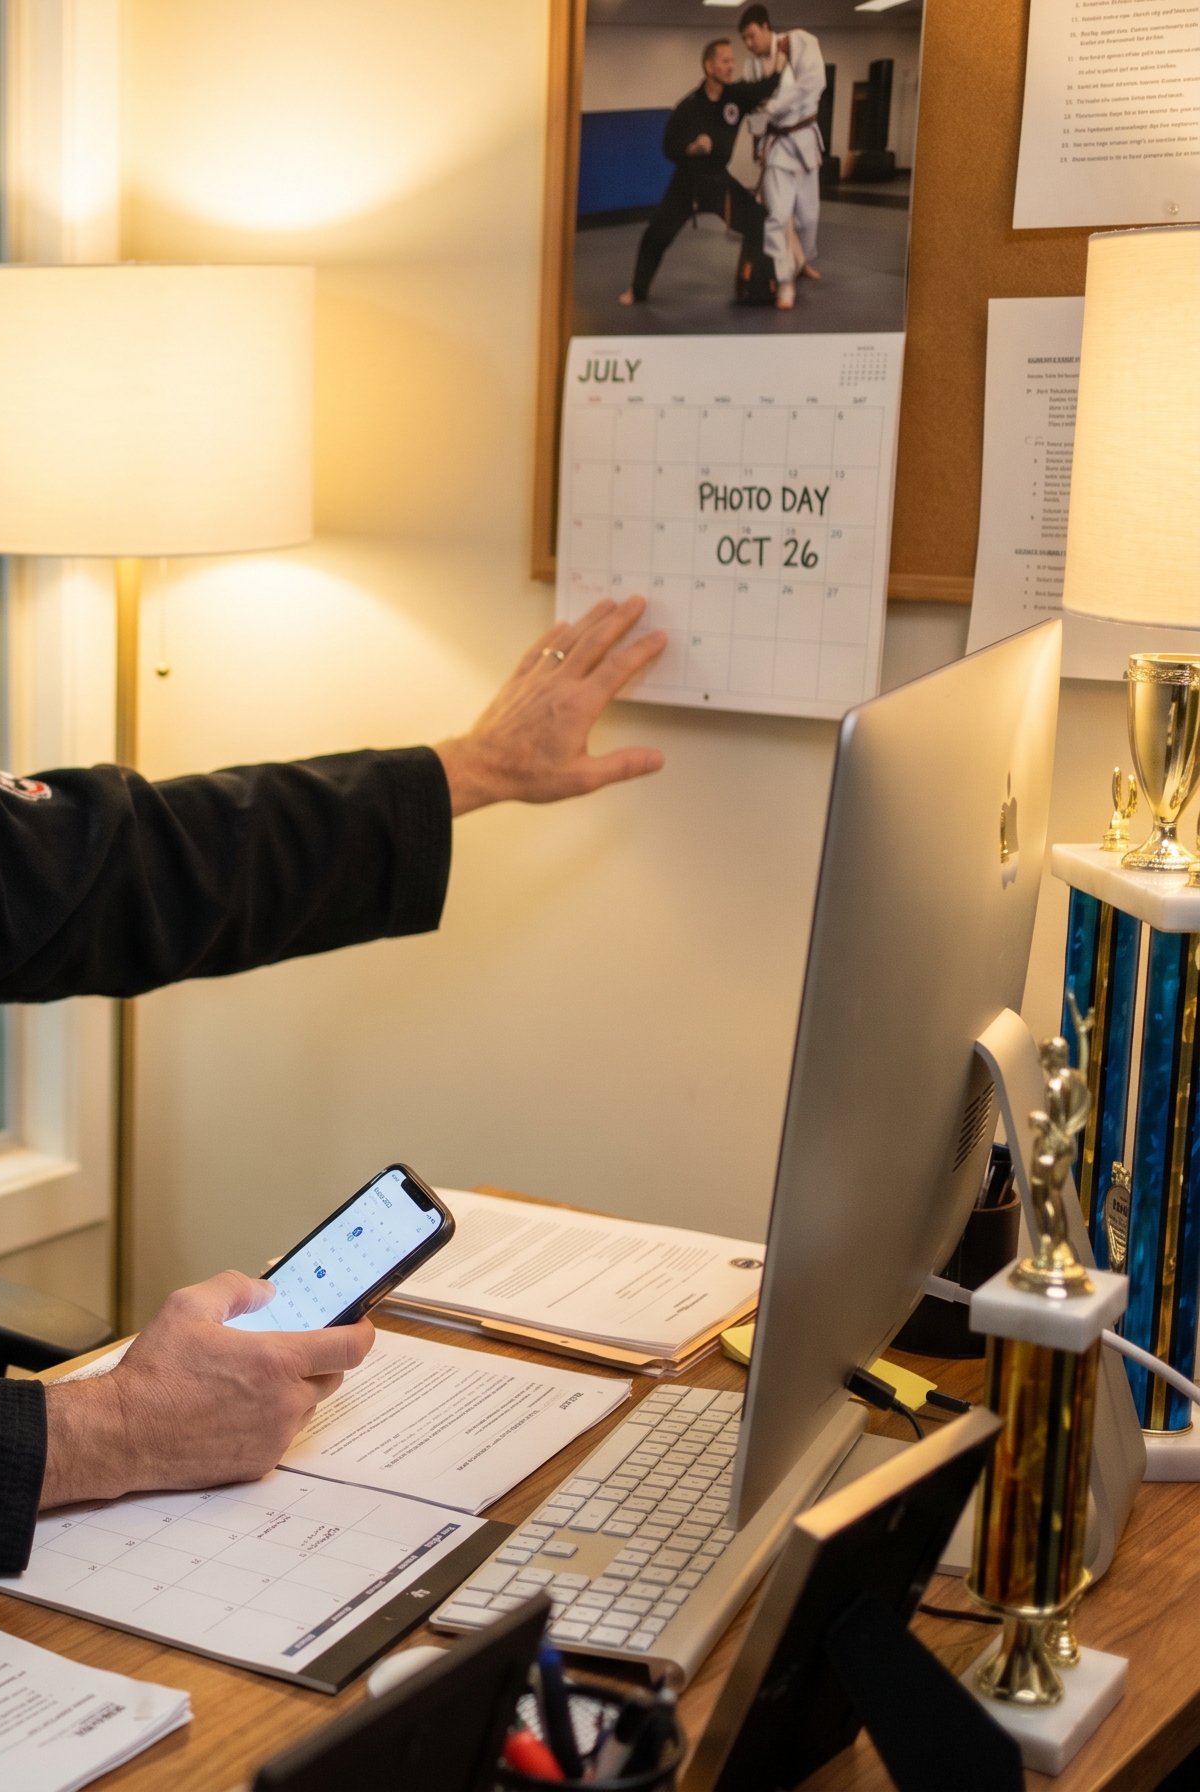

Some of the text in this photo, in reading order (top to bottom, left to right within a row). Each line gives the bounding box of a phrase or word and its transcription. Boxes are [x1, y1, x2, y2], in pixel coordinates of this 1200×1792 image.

[577, 358, 642, 383] JULY
[852, 396, 868, 405] SAT
[837, 411, 844, 421] 6
[743, 468, 753, 477] 11
[699, 481, 830, 517] PHOTO DAY
[716, 535, 819, 569] OCT 26
[826, 587, 839, 598] 27
